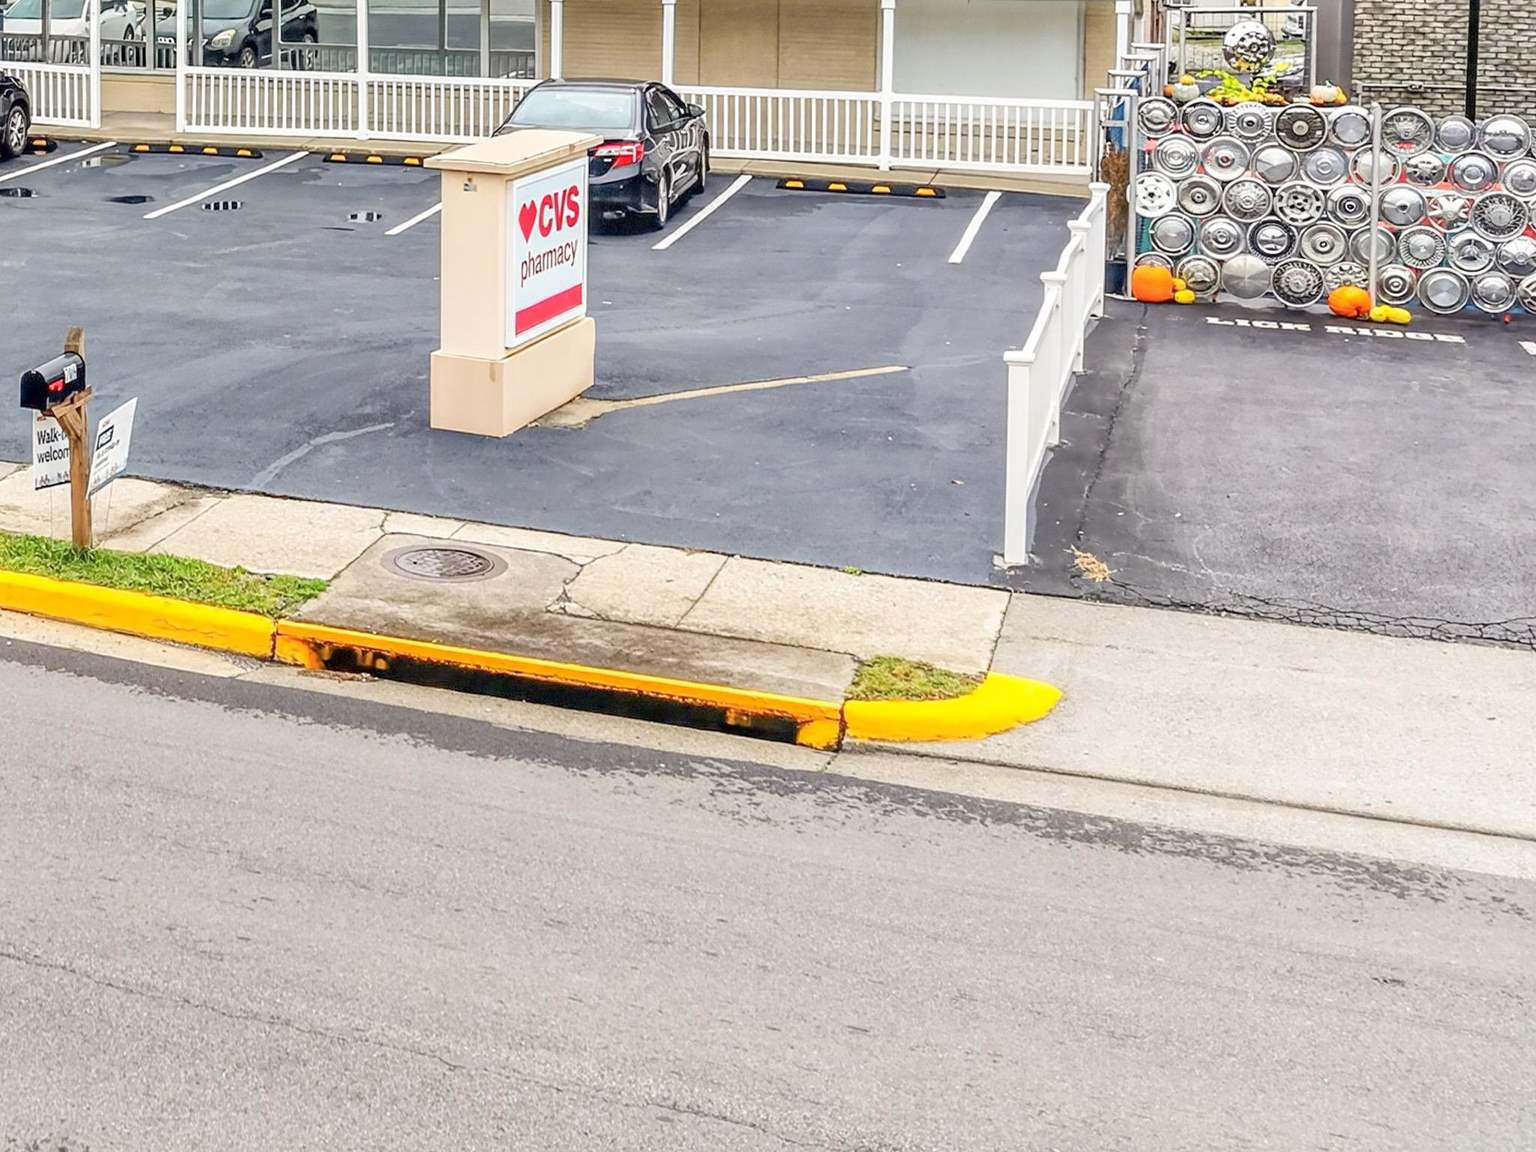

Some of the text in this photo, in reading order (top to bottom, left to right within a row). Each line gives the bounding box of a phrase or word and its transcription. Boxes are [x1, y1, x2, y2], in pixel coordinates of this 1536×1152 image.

[538, 184, 580, 238] CVS
[520, 239, 578, 288] pharmacy
[1205, 316, 1466, 344] LICK RIDGE
